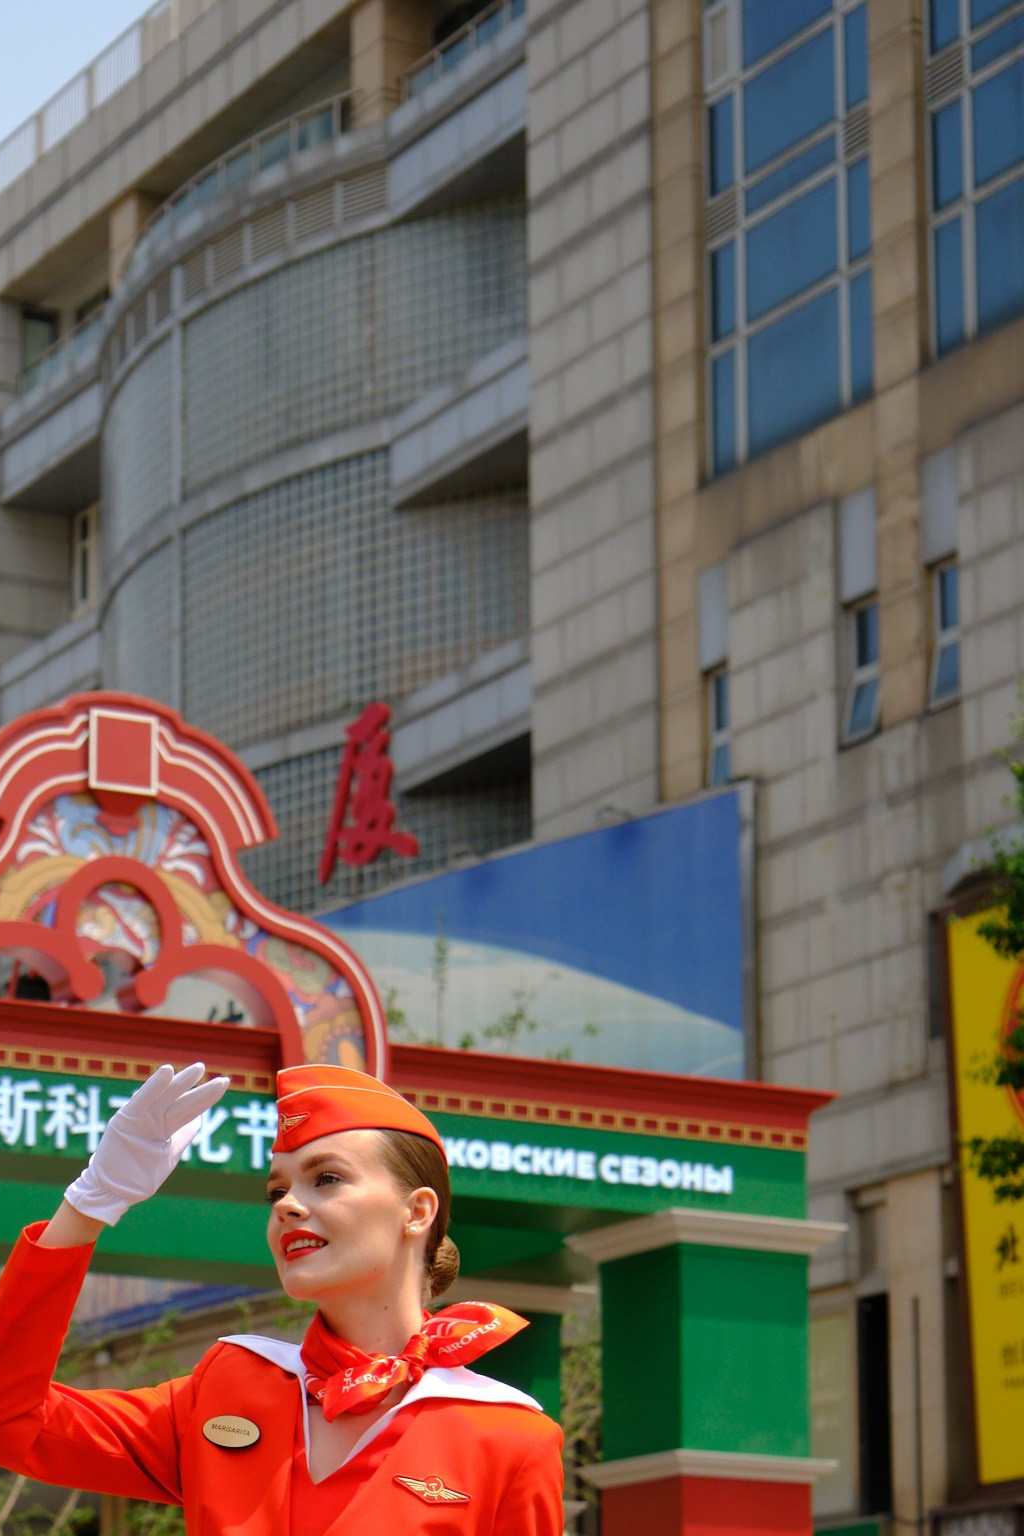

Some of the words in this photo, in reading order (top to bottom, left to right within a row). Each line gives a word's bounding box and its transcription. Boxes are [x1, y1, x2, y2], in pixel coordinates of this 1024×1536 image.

[440, 1136, 596, 1181] КОВСКИЕ
[599, 1153, 733, 1195] СЕЗОНЫ
[437, 1317, 502, 1356] AEROFLOT
[210, 1423, 251, 1437] MARGARITA
